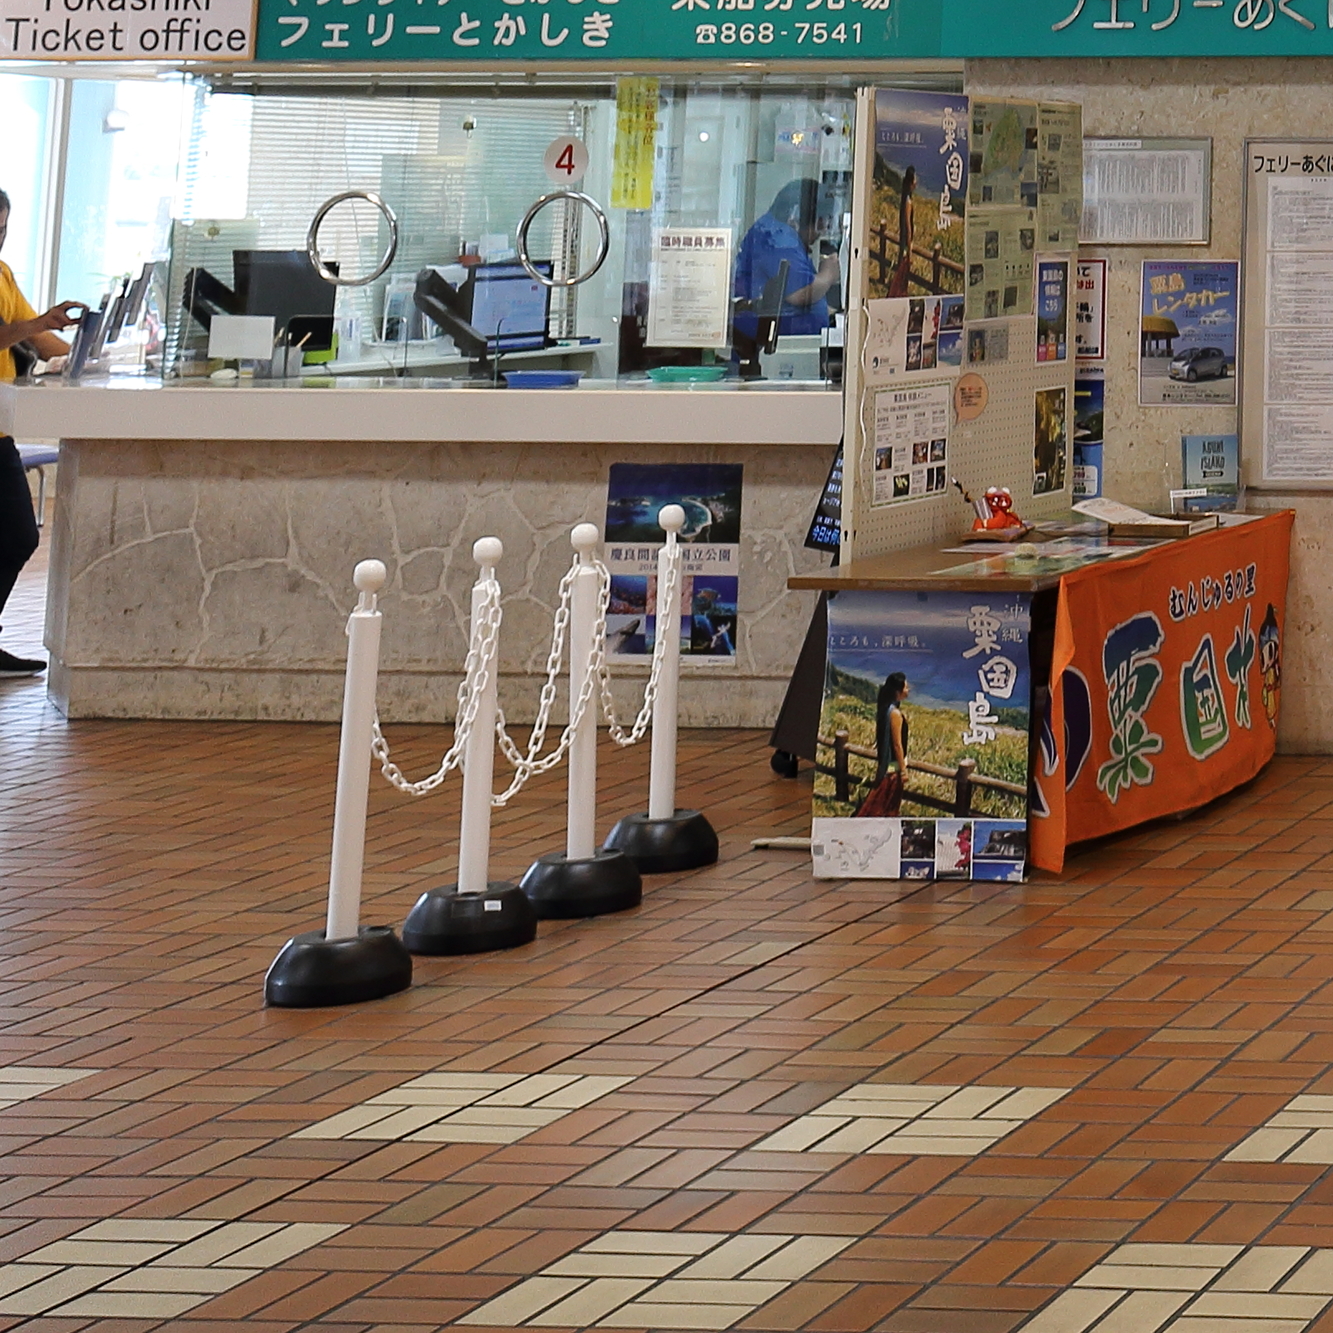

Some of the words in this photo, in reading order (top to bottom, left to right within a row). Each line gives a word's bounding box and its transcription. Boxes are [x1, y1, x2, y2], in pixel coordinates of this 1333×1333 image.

[5, 18, 123, 52] Ticket
[139, 17, 247, 53] office
[276, 12, 614, 48] フェリーとかしき
[720, 21, 863, 45] 868-7541
[555, 144, 576, 176] 4
[962, 604, 1018, 746] 粟国島
